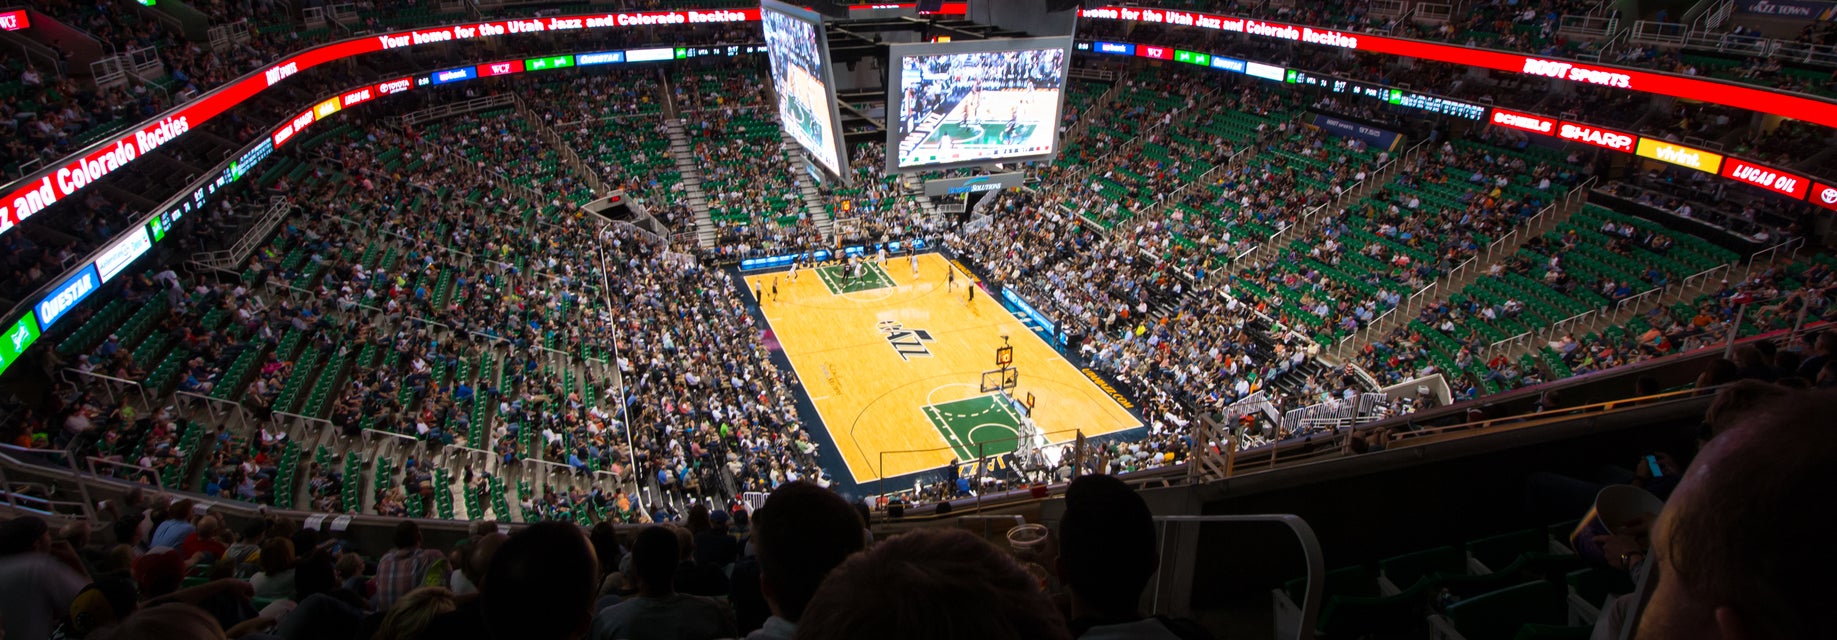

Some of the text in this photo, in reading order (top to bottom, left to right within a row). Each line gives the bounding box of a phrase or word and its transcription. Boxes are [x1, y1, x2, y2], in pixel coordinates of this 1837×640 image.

[378, 9, 746, 50] Your home for the Utah Jazz and Colorado Rockies
[1121, 8, 1140, 20] for
[1142, 10, 1163, 23] the
[1166, 11, 1193, 26] Utah
[1196, 15, 1220, 30] Jazz
[1223, 19, 1244, 32] and
[1246, 21, 1300, 41] Colorado
[1303, 28, 1358, 49] Rockies
[491, 64, 510, 74] WCF
[1523, 58, 1631, 89] ROOT SPORTS
[1493, 112, 1553, 133] SCHEELS
[1560, 124, 1631, 151] SHARP
[14, 176, 57, 221] and
[57, 140, 136, 195] Colorado
[136, 115, 189, 154] Rockies
[1732, 164, 1797, 193] LUCAS OIL
[41, 273, 92, 324] QUESTAR
